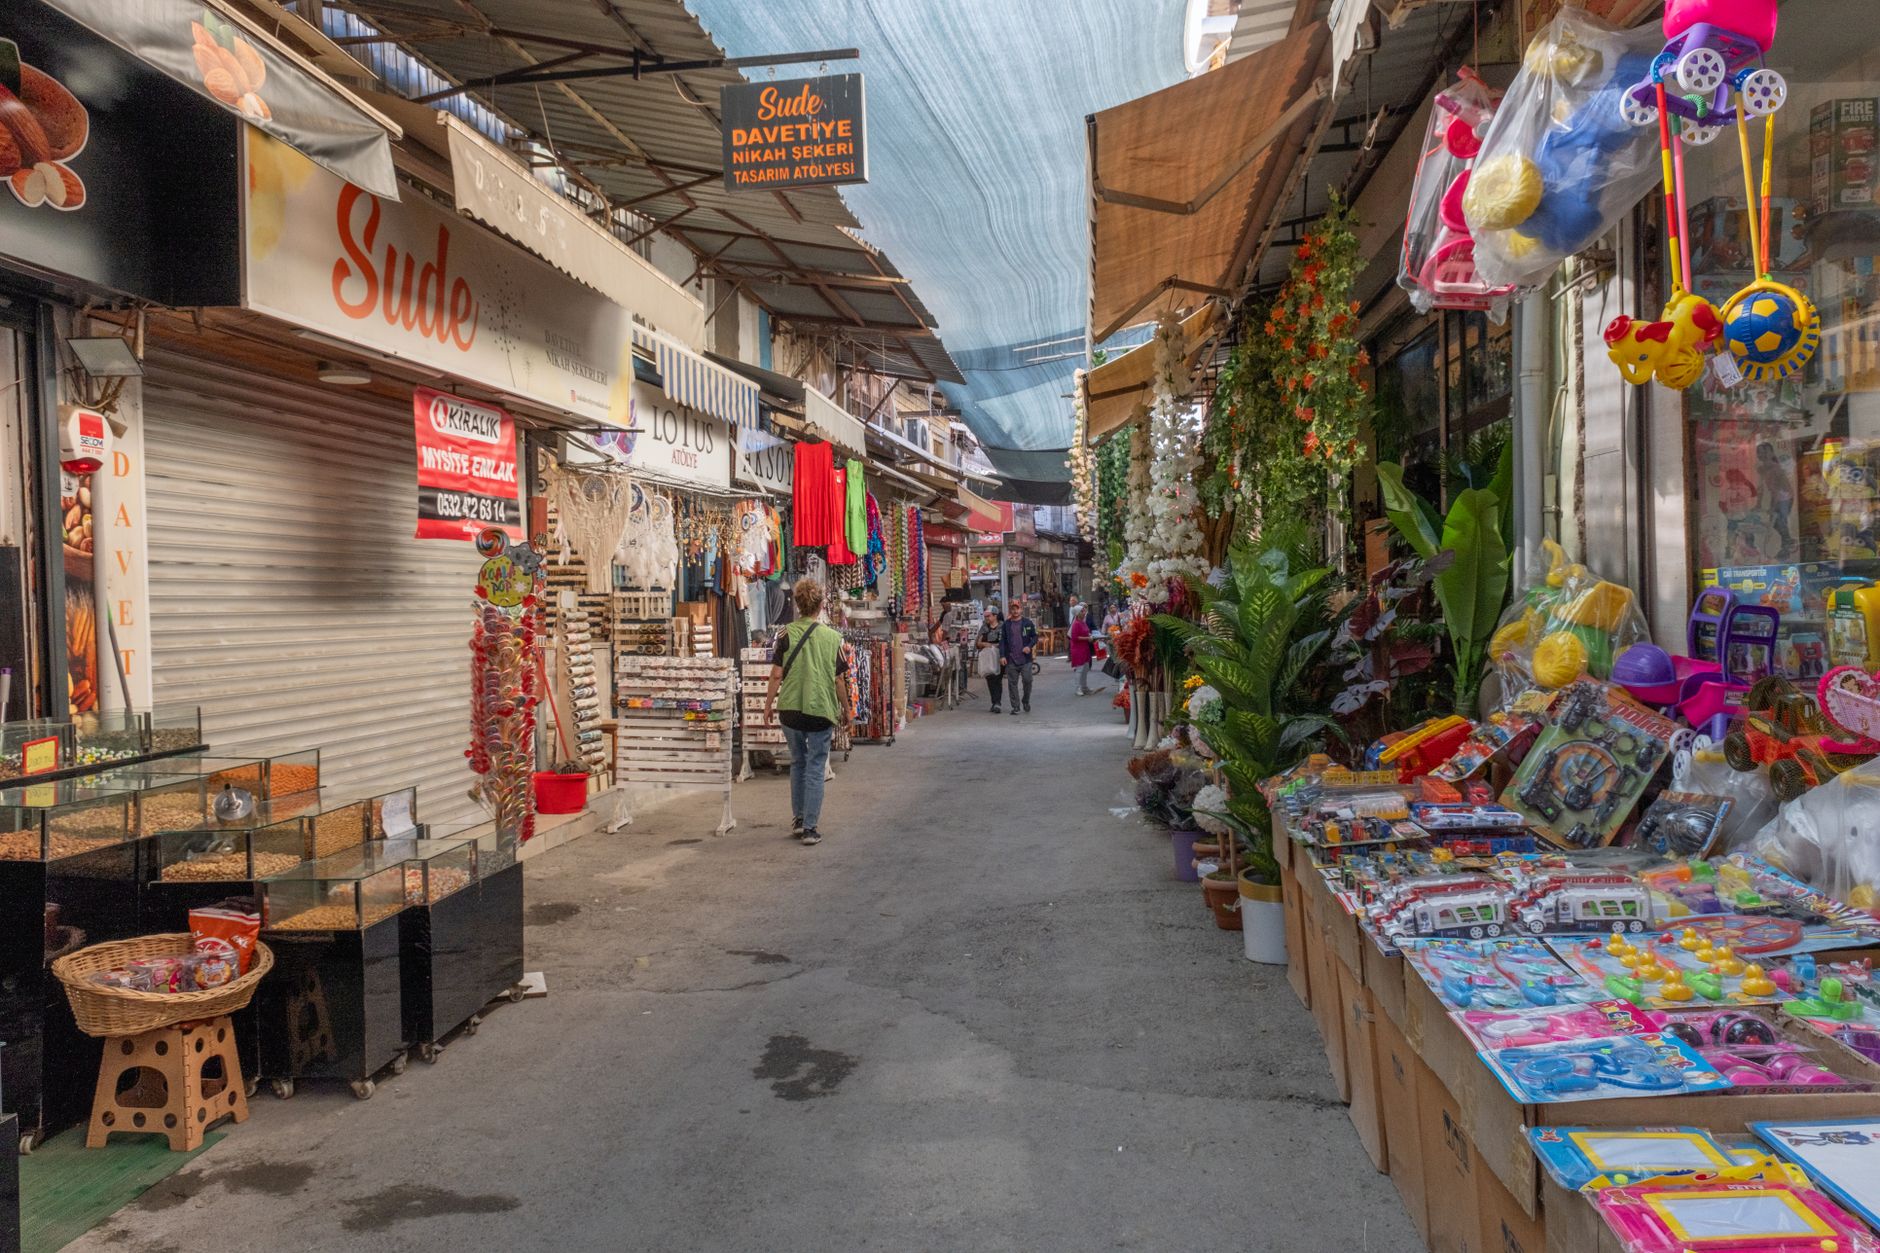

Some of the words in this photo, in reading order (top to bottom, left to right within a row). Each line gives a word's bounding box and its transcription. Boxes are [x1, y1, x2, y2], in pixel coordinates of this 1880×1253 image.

[757, 83, 824, 121] Sude
[1840, 101, 1873, 115] FIRE
[732, 118, 852, 147] DAVETİYE
[732, 146, 786, 165] NİKAH
[792, 139, 853, 162] ŞEKERİ
[733, 167, 790, 184] TASARIM
[332, 182, 479, 352] Sude
[545, 347, 571, 373] NİKAH
[571, 360, 608, 386] ŞEKERLERİ
[448, 403, 499, 439] KİRALIK
[652, 402, 714, 454] LOTUS
[422, 446, 469, 476] MYSİTE
[472, 456, 516, 482] EMLAK
[671, 448, 698, 469] ATÖLYE
[437, 492, 462, 517] 0532
[479, 498, 492, 520] 63
[494, 500, 505, 522] 14
[112, 451, 135, 676] DAVET
